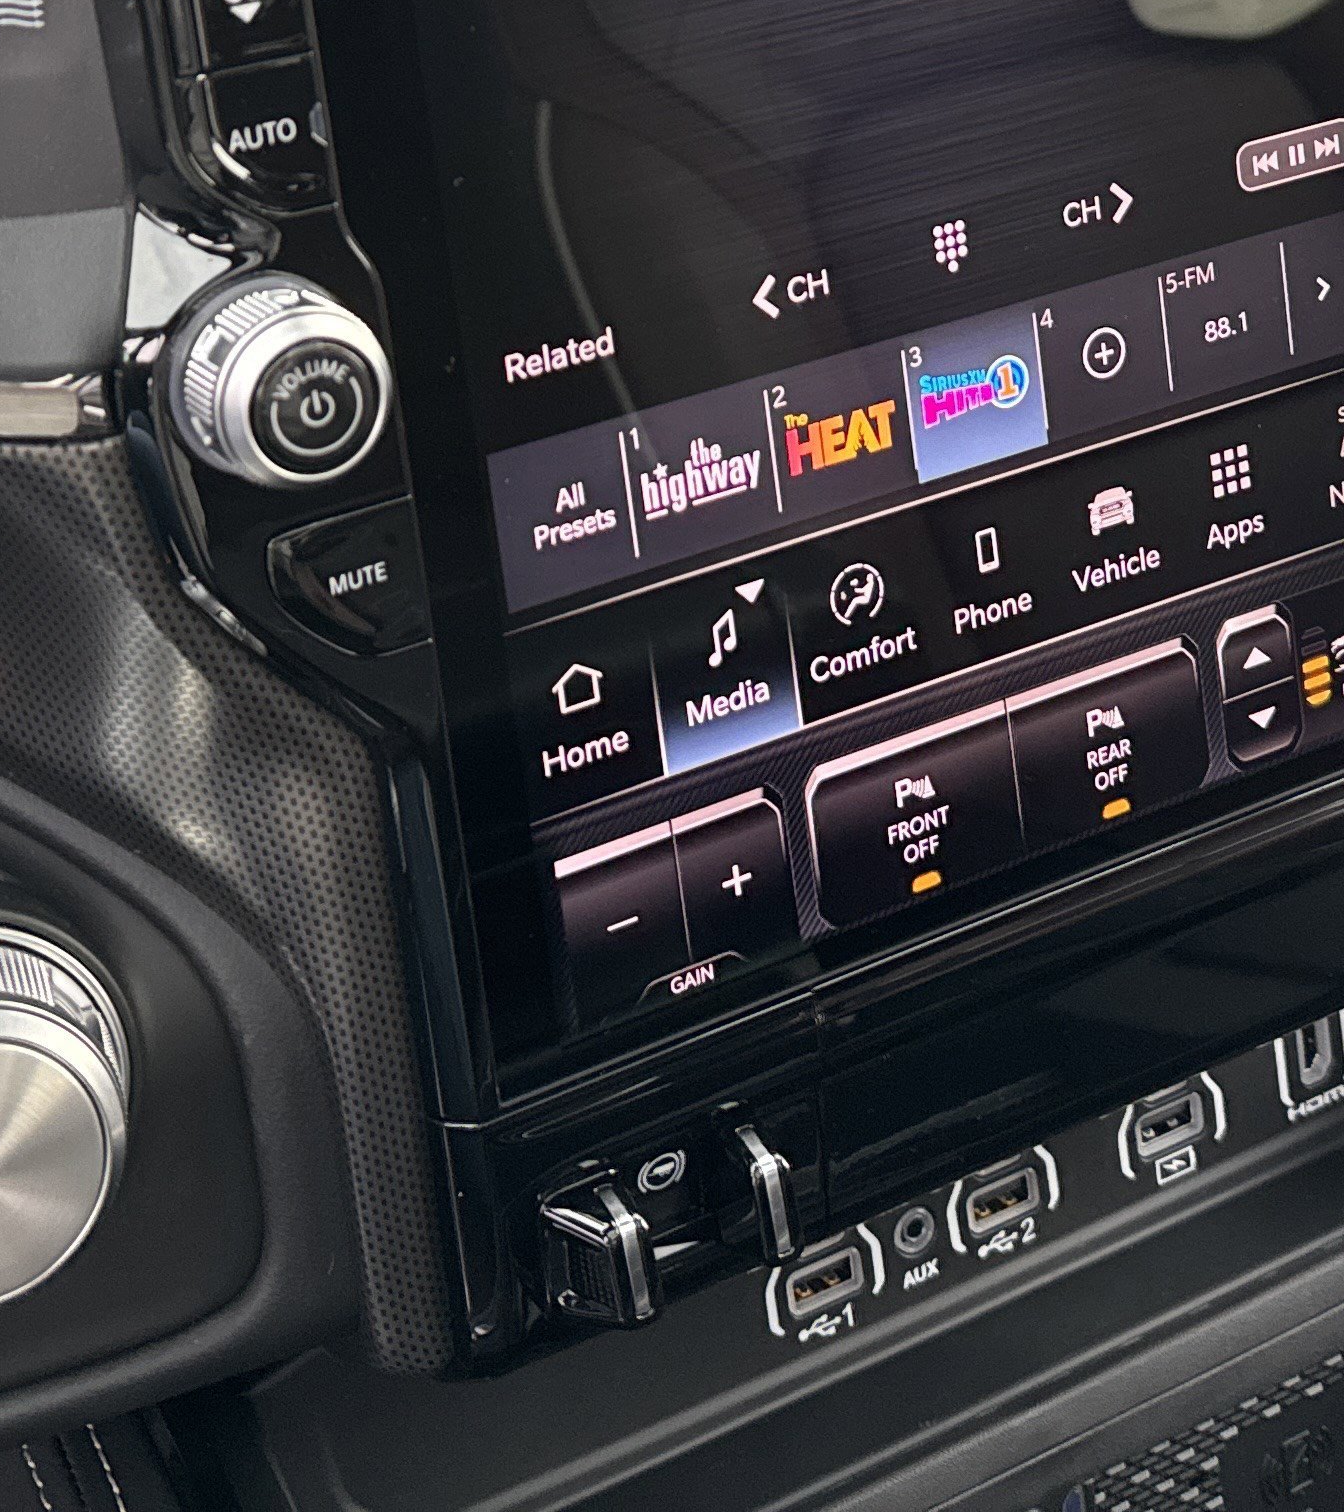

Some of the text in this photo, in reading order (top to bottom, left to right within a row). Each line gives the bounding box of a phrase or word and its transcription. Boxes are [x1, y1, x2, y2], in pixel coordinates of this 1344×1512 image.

[228, 116, 297, 154] AUTO
[1062, 195, 1101, 226] CH
[786, 269, 830, 304] CH
[1165, 263, 1215, 294] 5-FM
[1039, 308, 1053, 329] 4
[1205, 311, 1248, 342] 88.1
[504, 326, 616, 383] Related
[908, 346, 922, 367] 3
[272, 358, 351, 400] VOLUME
[772, 385, 787, 409] 2
[783, 411, 809, 429] The
[629, 427, 641, 451] 1
[690, 437, 722, 466] the
[785, 399, 895, 477] HEAT
[641, 448, 761, 514] highway
[555, 482, 586, 513] All
[534, 506, 617, 550] Presets
[1206, 513, 1265, 550] Apps
[328, 561, 389, 597] MUTE
[1072, 547, 1161, 592] Vehicle
[953, 591, 1033, 635] Phone
[810, 627, 918, 684] Comfort
[685, 679, 770, 727] Media
[542, 729, 630, 778] Home
[1086, 739, 1131, 769] REAR
[1094, 762, 1128, 792] OFF
[887, 804, 949, 846] FRONT
[903, 835, 940, 865] OFF
[669, 963, 715, 994] GAIN
[1021, 1216, 1037, 1243] 2
[902, 1258, 941, 1290] AUX
[842, 1303, 856, 1328] 1
